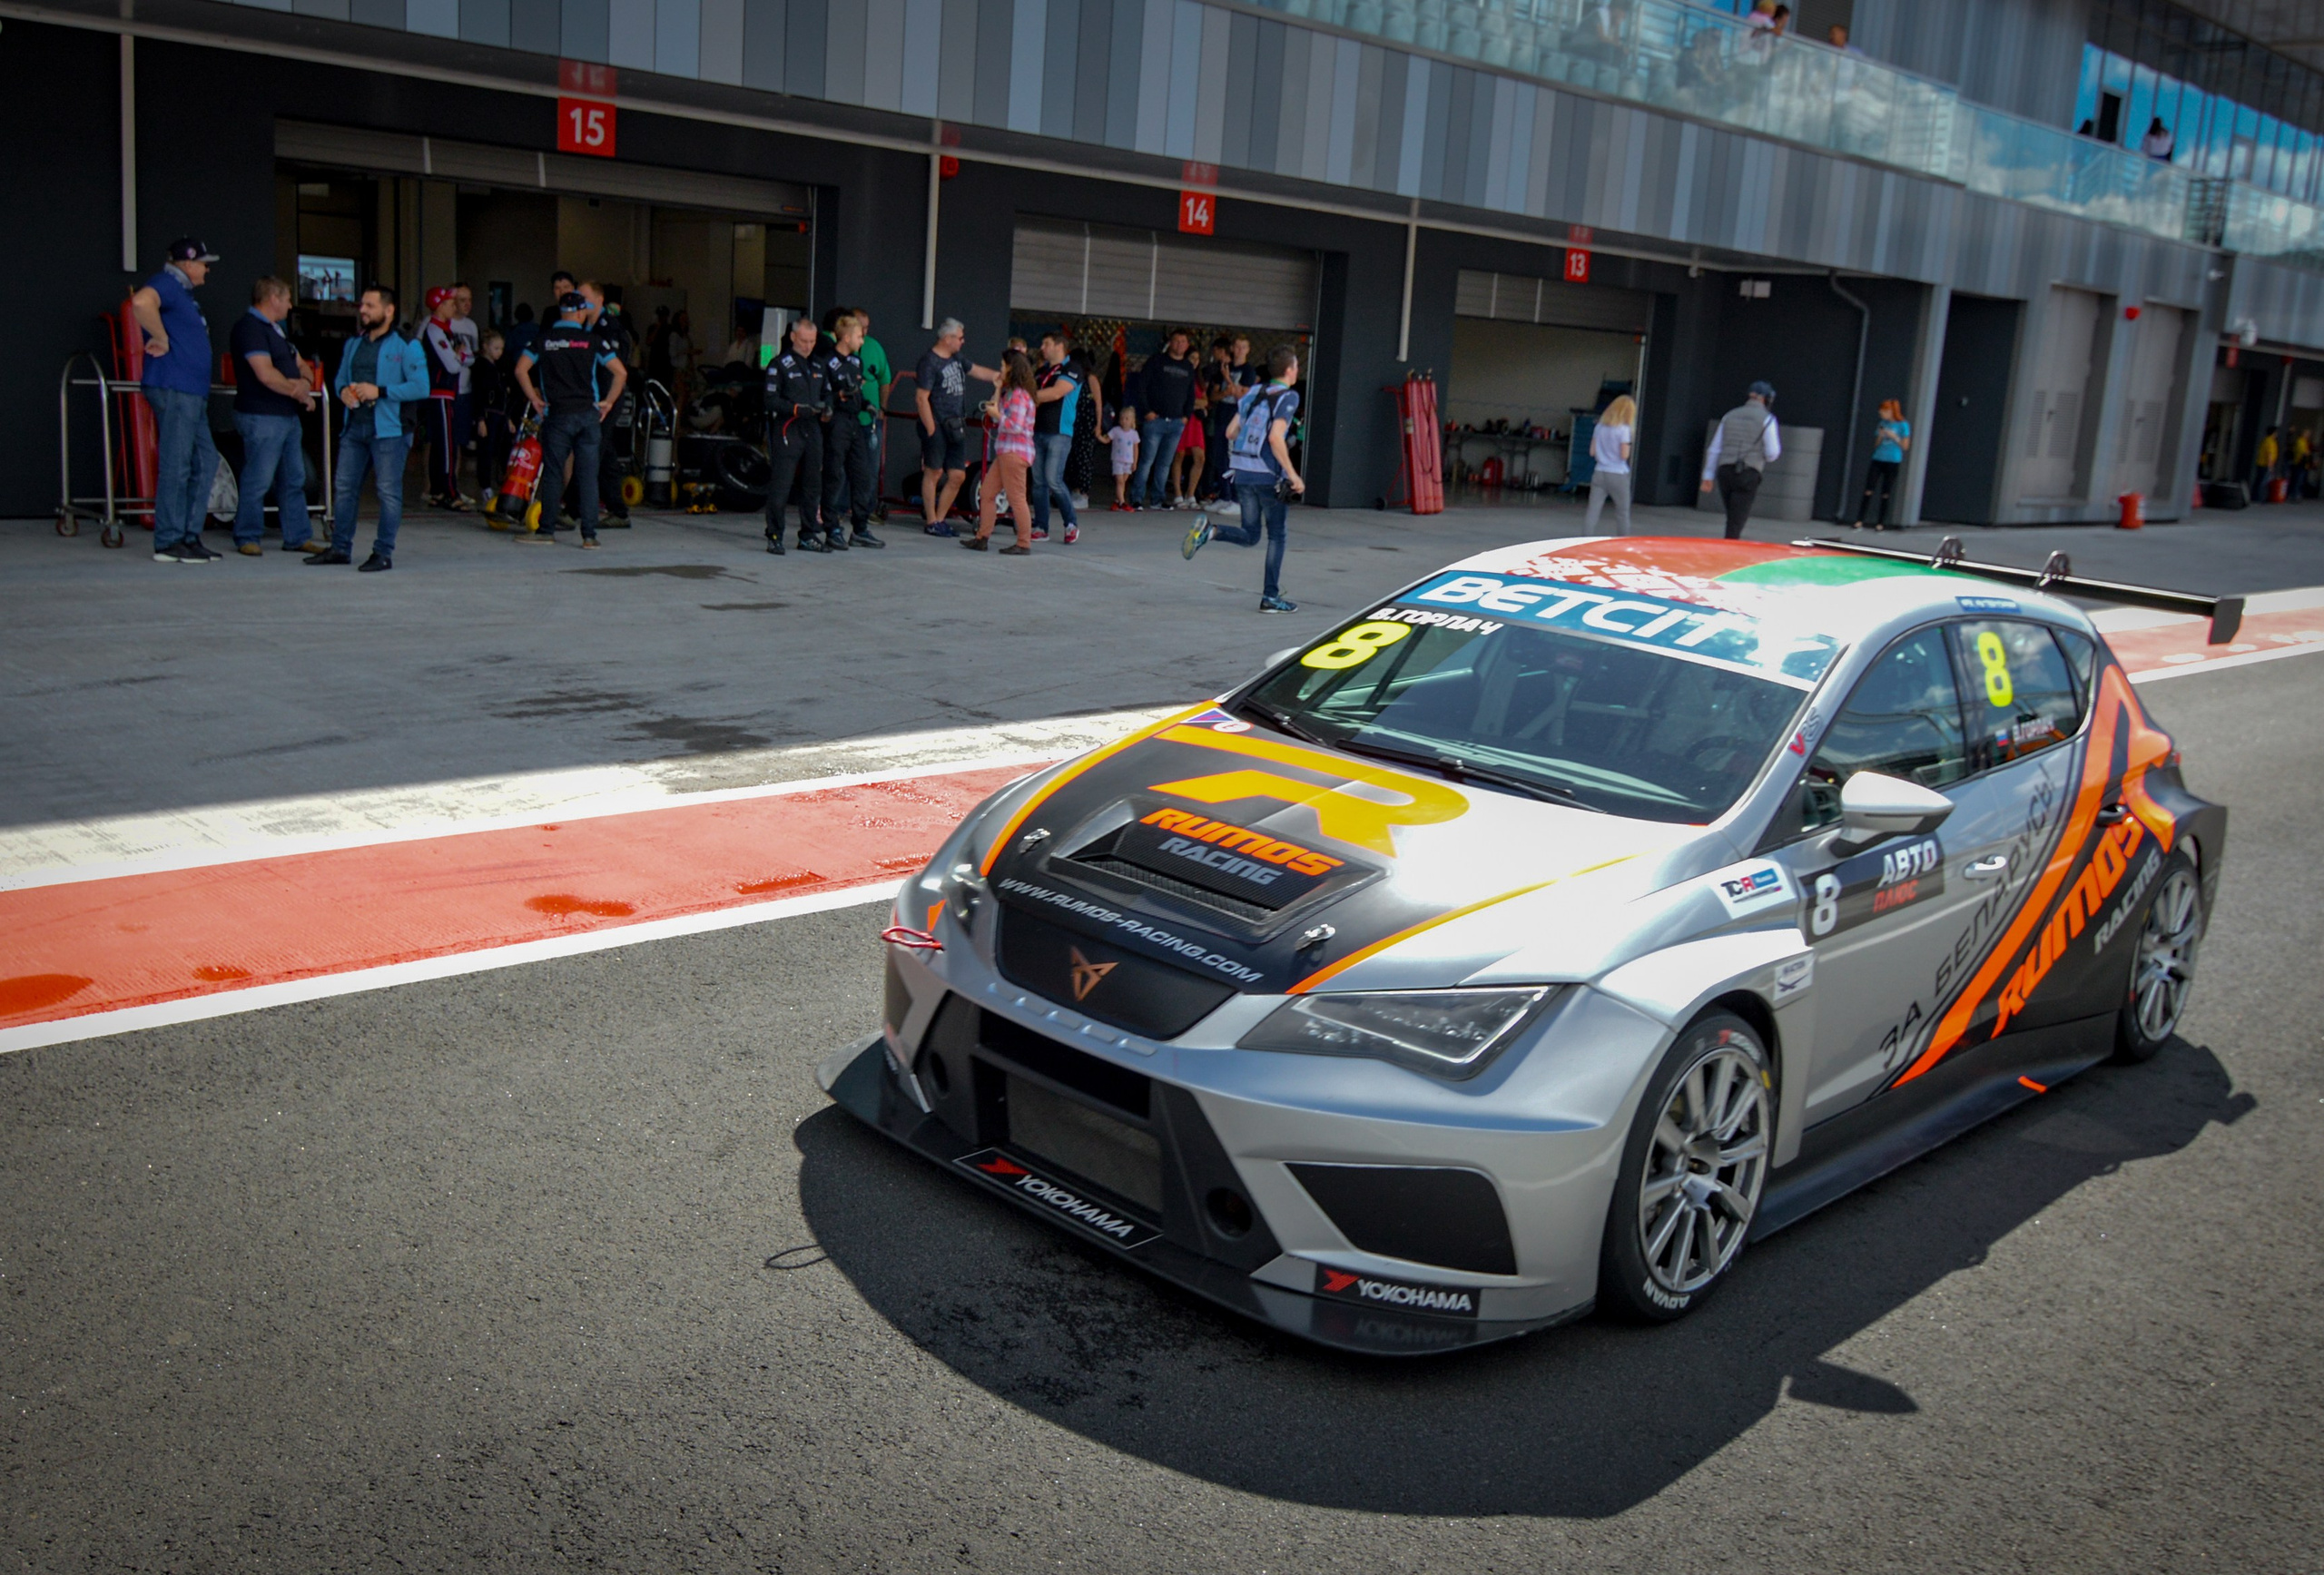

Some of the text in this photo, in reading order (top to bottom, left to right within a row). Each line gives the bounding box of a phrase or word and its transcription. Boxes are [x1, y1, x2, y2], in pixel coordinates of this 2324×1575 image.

[570, 107, 605, 146] 15
[1187, 198, 1209, 227] 14
[1571, 252, 1586, 277] 13
[1301, 622, 1411, 669] 8
[1977, 632, 2013, 707] 8
[1139, 807, 1345, 876] RUMOS
[1157, 837, 1284, 885] RACING
[1877, 840, 1937, 888] АВТО
[1720, 876, 1757, 898] TCR
[1812, 873, 1841, 936] 8
[2094, 849, 2162, 954] RACING
[1000, 878, 1265, 983] WWW.RUMOS-RACING.COM
[1990, 795, 2144, 1039] RUMOS
[1015, 1175, 1134, 1237] YOKOHAMA
[1357, 1279, 1472, 1311] YOKOHAMA
[1642, 1275, 1690, 1309] ADVAN
